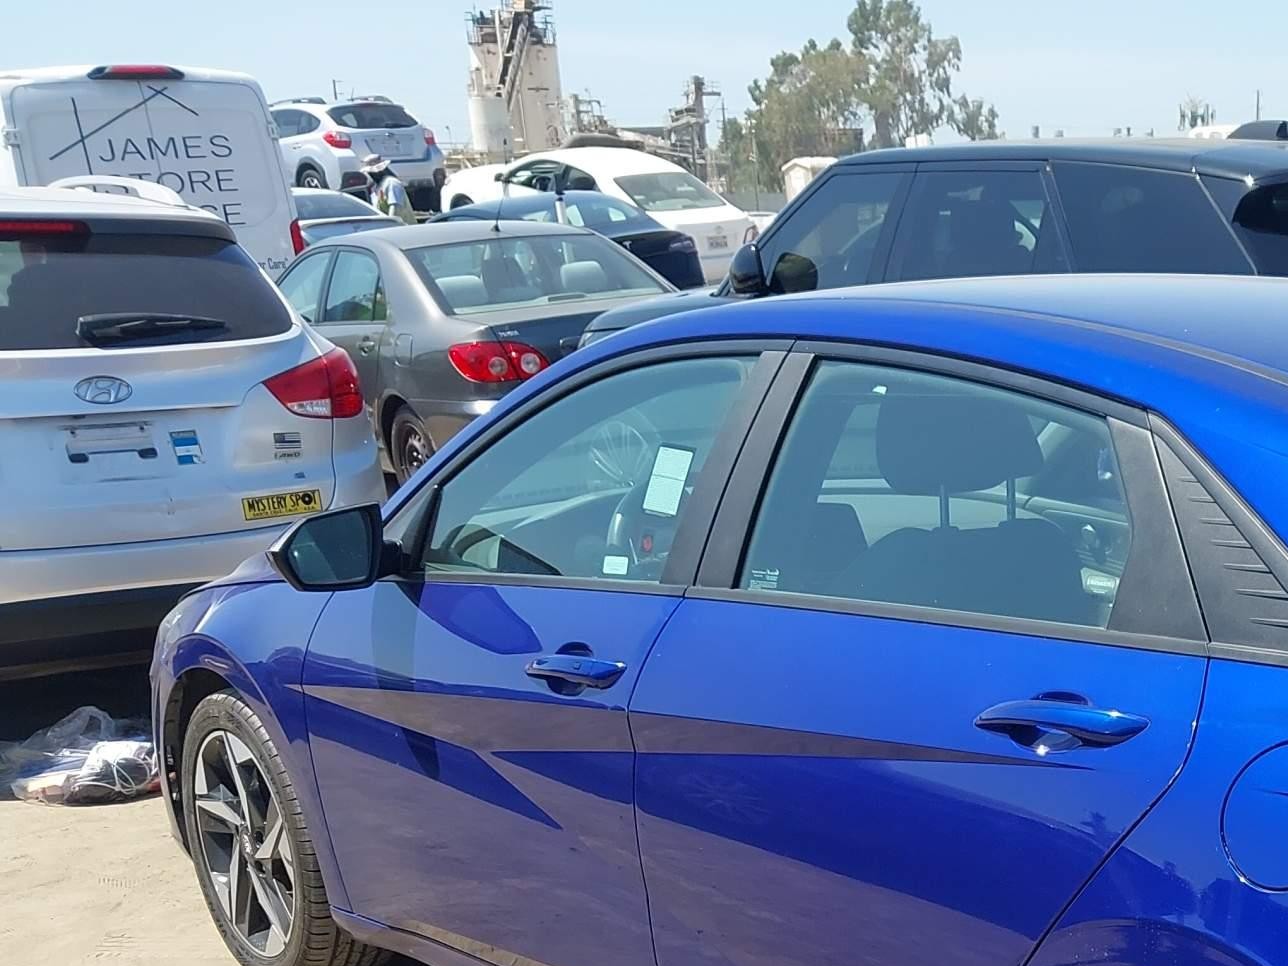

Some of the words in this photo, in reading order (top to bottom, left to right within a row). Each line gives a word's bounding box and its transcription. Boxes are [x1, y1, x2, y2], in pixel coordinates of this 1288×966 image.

[98, 134, 233, 162] JAMES
[246, 494, 288, 512] MYSTERY
[289, 491, 317, 508] SPOT
